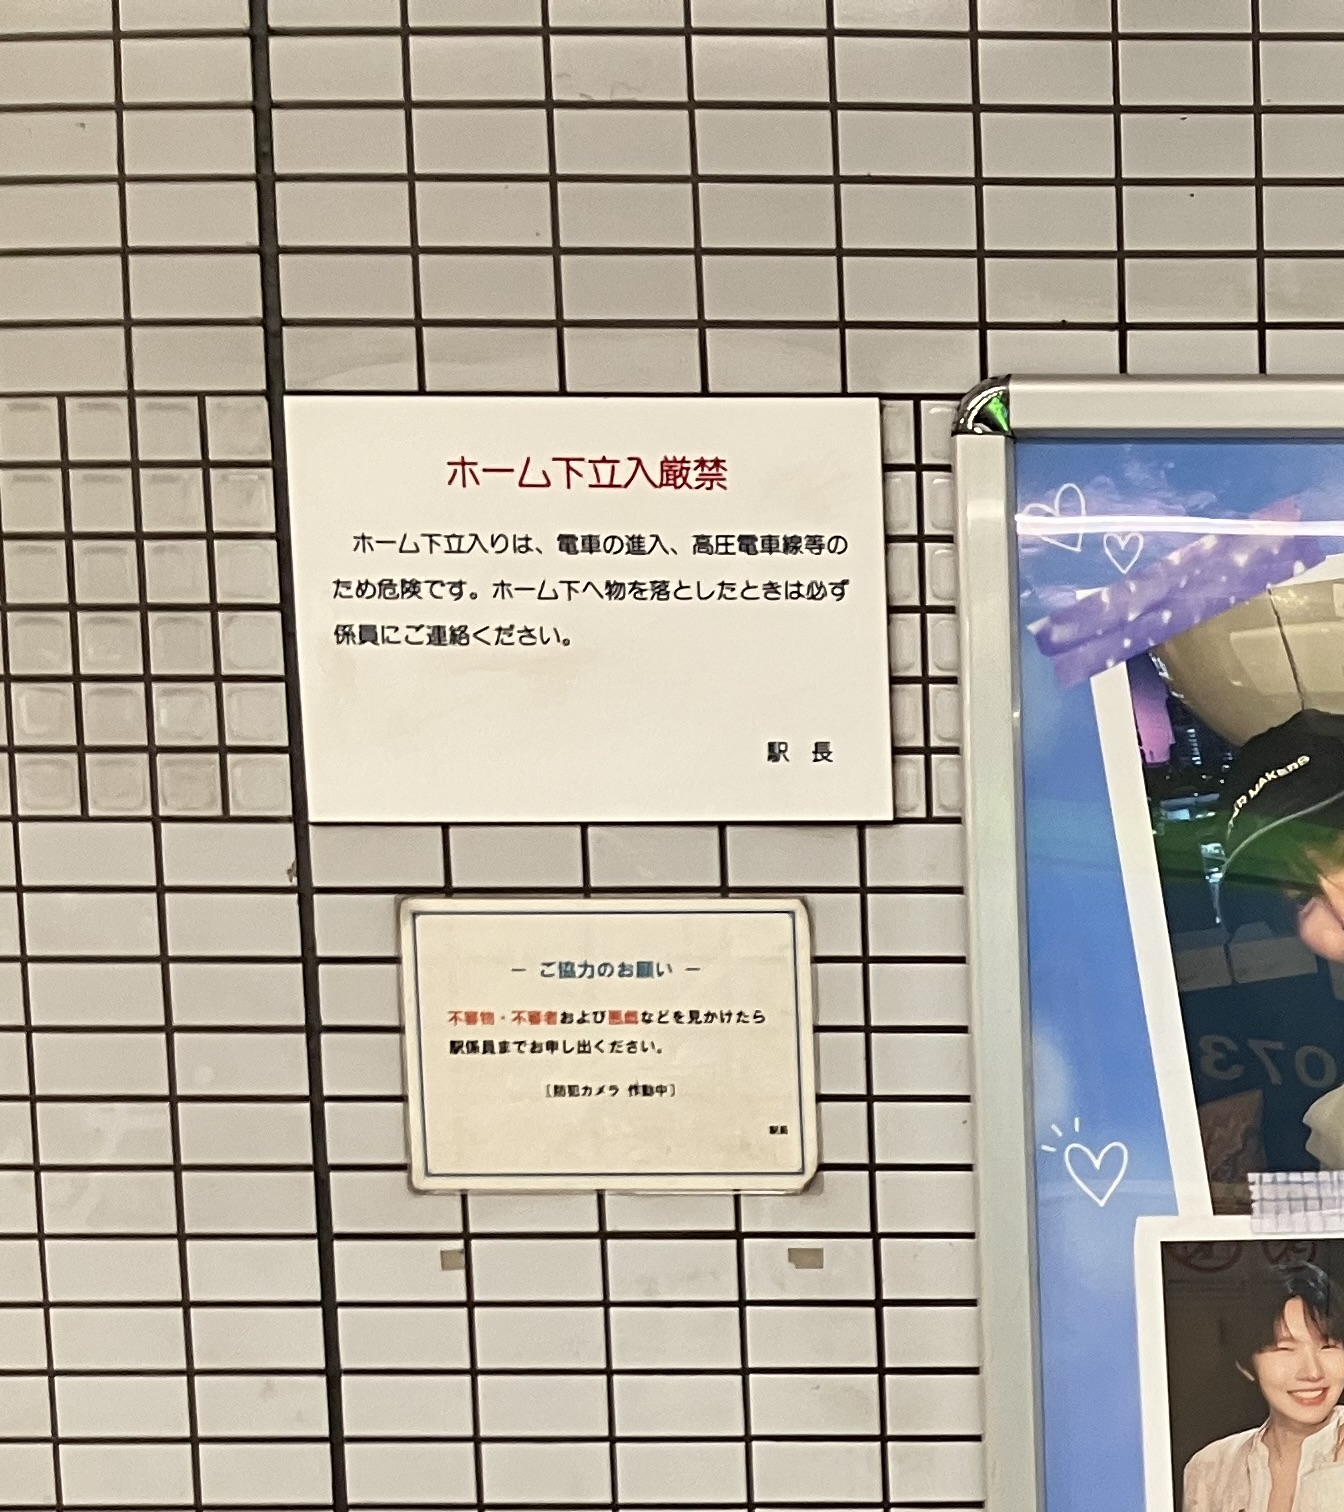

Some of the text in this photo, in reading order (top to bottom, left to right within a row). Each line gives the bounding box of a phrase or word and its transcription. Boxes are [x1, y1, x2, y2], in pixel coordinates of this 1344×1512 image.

[447, 456, 728, 491] ホーム下立入厳禁
[333, 623, 573, 647] 係員にご連絡ください。
[540, 960, 673, 979] ご協力のお願い
